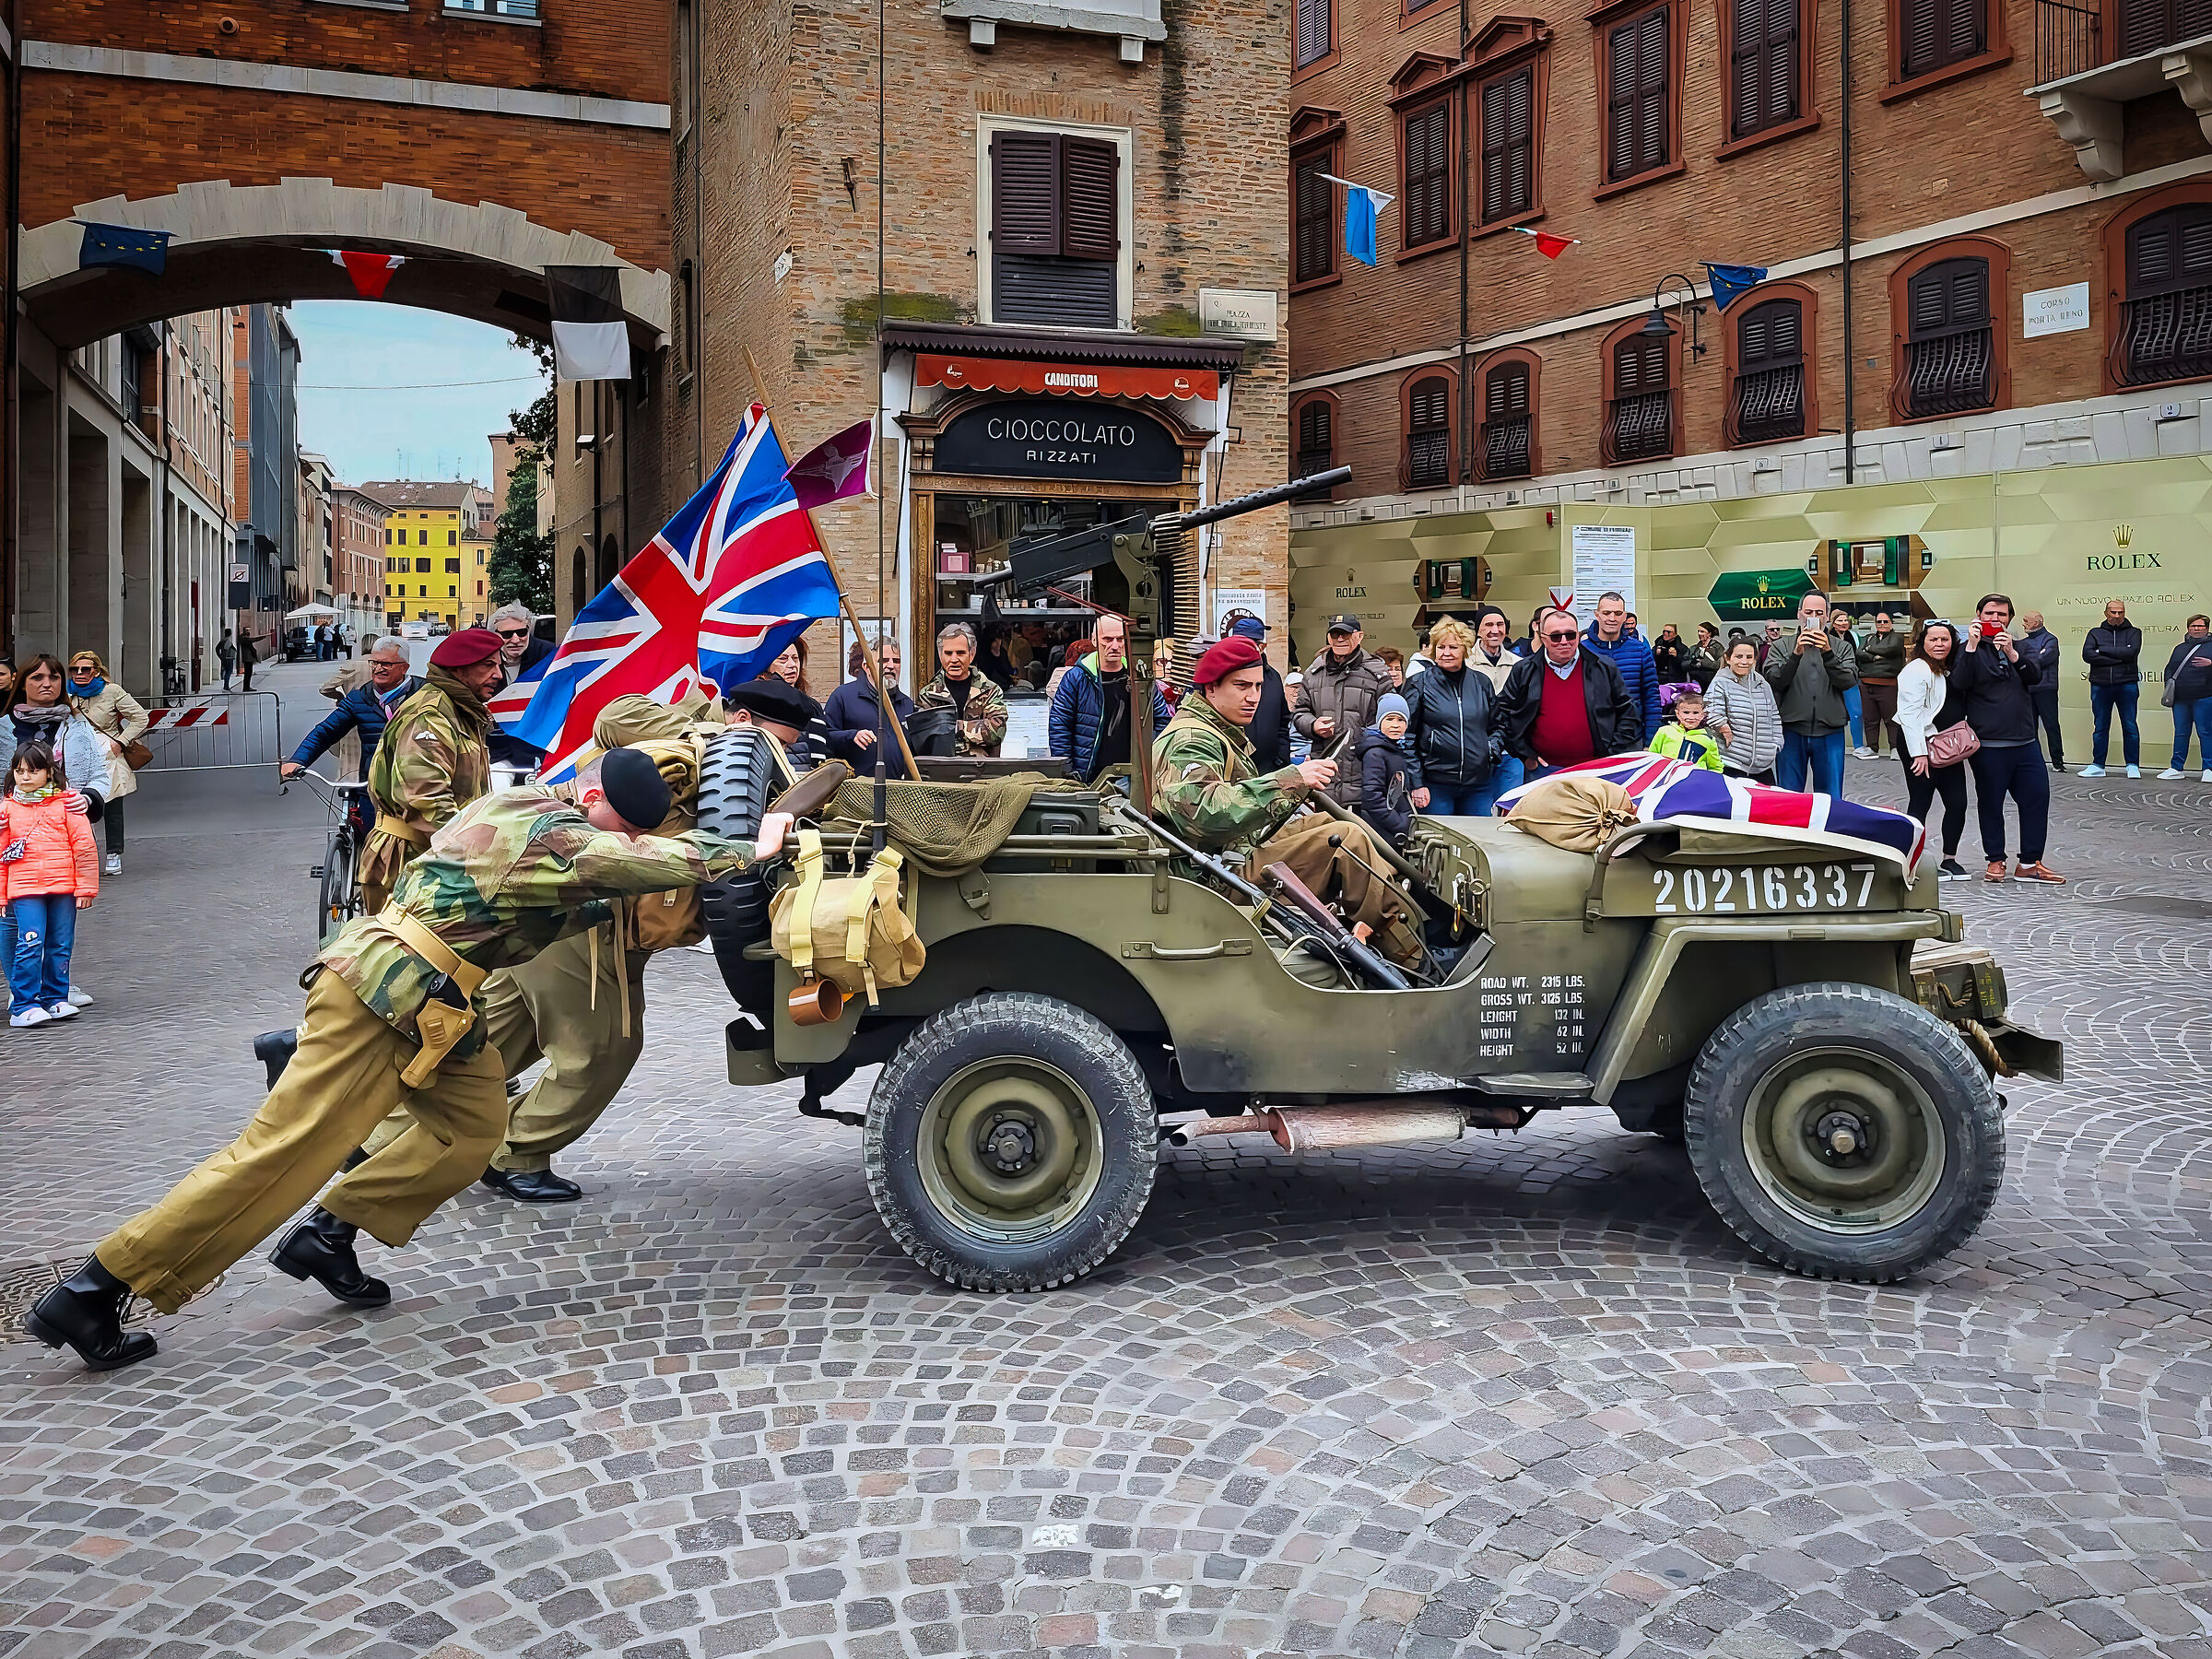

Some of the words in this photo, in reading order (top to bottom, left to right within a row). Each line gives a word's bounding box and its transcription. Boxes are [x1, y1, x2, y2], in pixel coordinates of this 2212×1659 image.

[2041, 297, 2070, 309] CORSO
[2029, 314, 2056, 325] PORTA
[987, 418, 1135, 446] CIOCCOLATO
[1027, 450, 1096, 464] RIZZATI
[2087, 553, 2162, 571] ROLEX
[1335, 586, 1367, 598] ROLEX
[1741, 596, 1786, 609] ROLEX
[2075, 596, 2112, 606] NUOVO
[2158, 594, 2195, 603] ROLEX
[1653, 865, 1876, 912] 20216337
[1480, 977, 1507, 989] ROAD
[1512, 977, 1529, 989] WT.
[1541, 976, 1561, 988] 2315
[1565, 975, 1585, 987] LBS.
[1480, 994, 1512, 1006] GROSS
[1518, 993, 1535, 1005] WT.
[1540, 993, 1560, 1005] 3125
[1565, 992, 1585, 1004] LBS.
[1480, 1010, 1518, 1023] LENGHT
[1555, 1008, 1568, 1020] 132
[1480, 1028, 1512, 1040] WIDTH
[1557, 1026, 1568, 1037] 62
[1479, 1044, 1513, 1056] HEIGHT
[1556, 1041, 1567, 1053] 52
